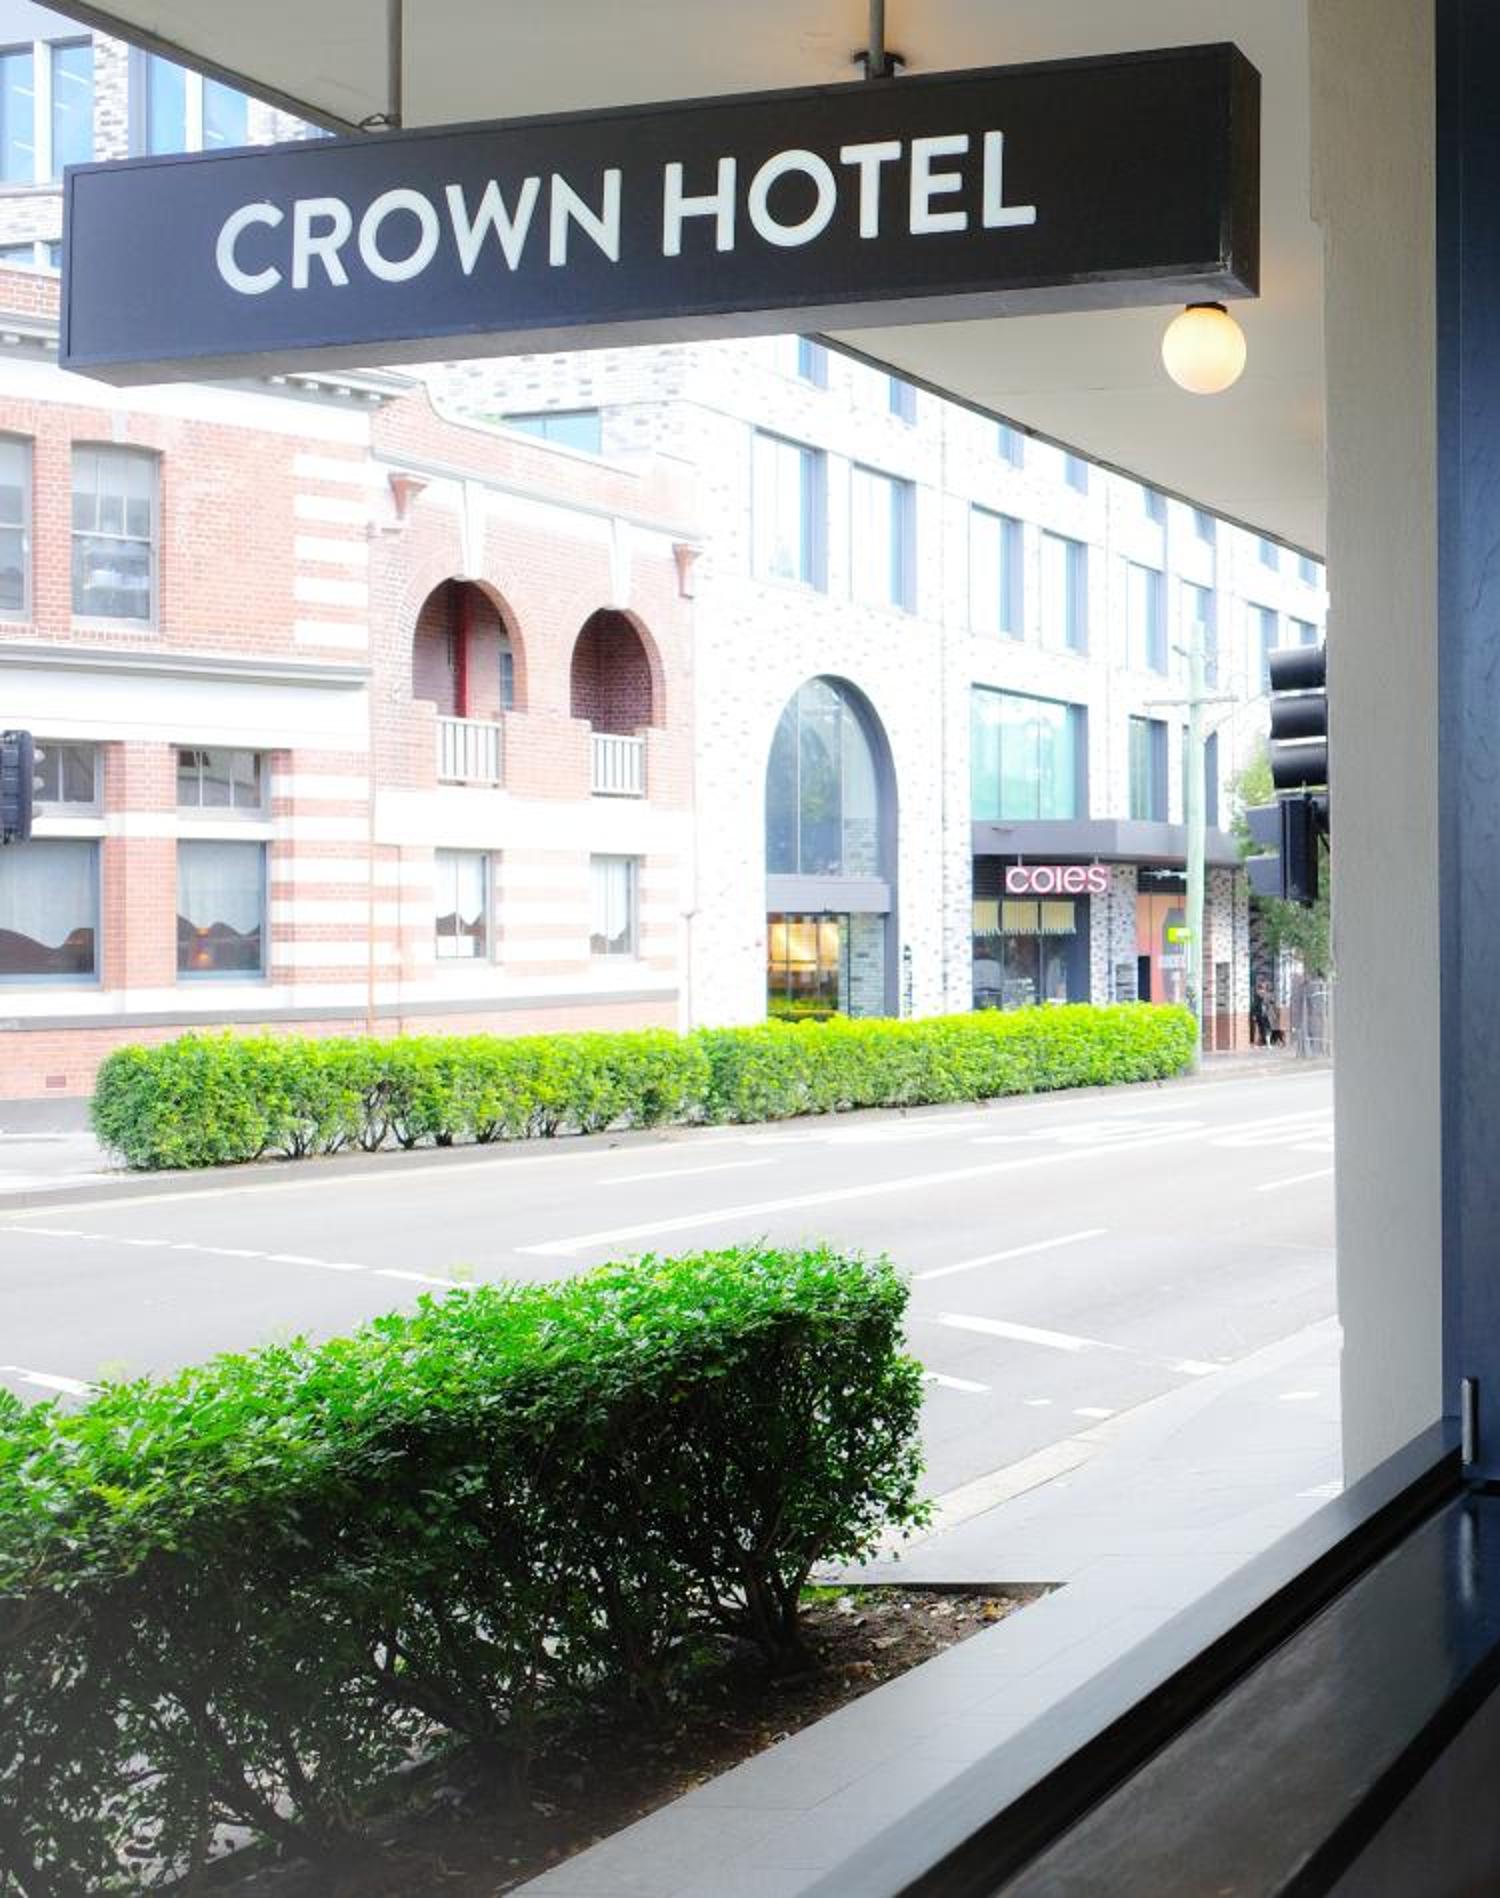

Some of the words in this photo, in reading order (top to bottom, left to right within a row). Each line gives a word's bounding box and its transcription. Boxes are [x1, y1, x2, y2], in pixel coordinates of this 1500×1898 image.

[214, 168, 621, 296] CROWN
[662, 130, 1037, 257] HOTEL
[1006, 866, 1106, 893] coles
